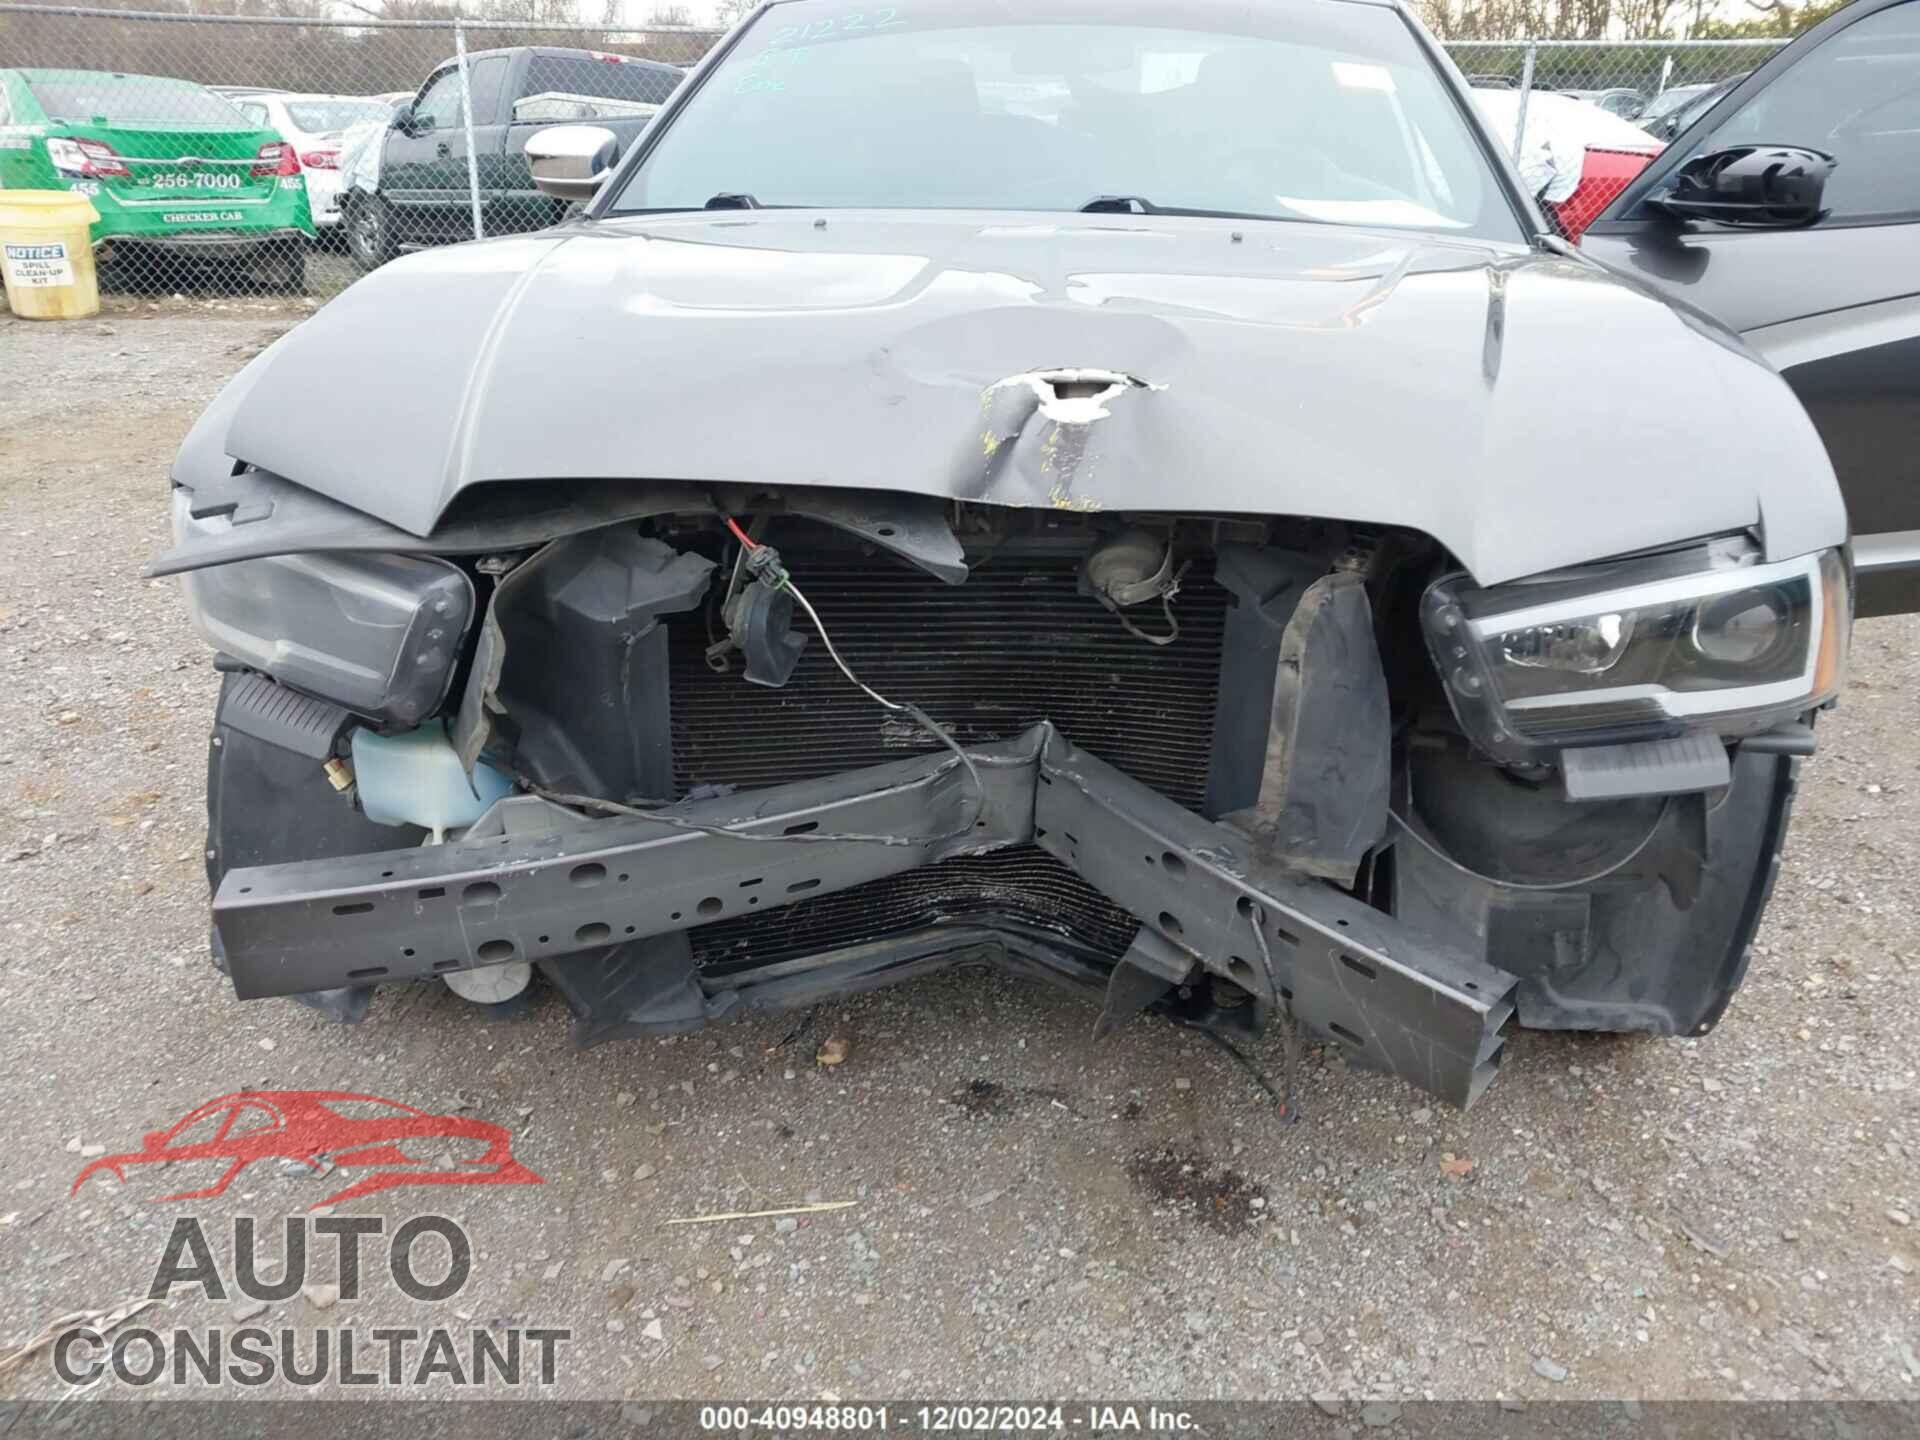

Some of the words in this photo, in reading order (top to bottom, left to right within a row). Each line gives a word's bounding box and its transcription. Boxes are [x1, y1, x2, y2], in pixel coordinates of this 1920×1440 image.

[152, 173, 240, 189] 256-7000
[163, 213, 219, 223] CHECKER
[220, 211, 243, 221] CAB
[7, 246, 62, 258] NOTICE
